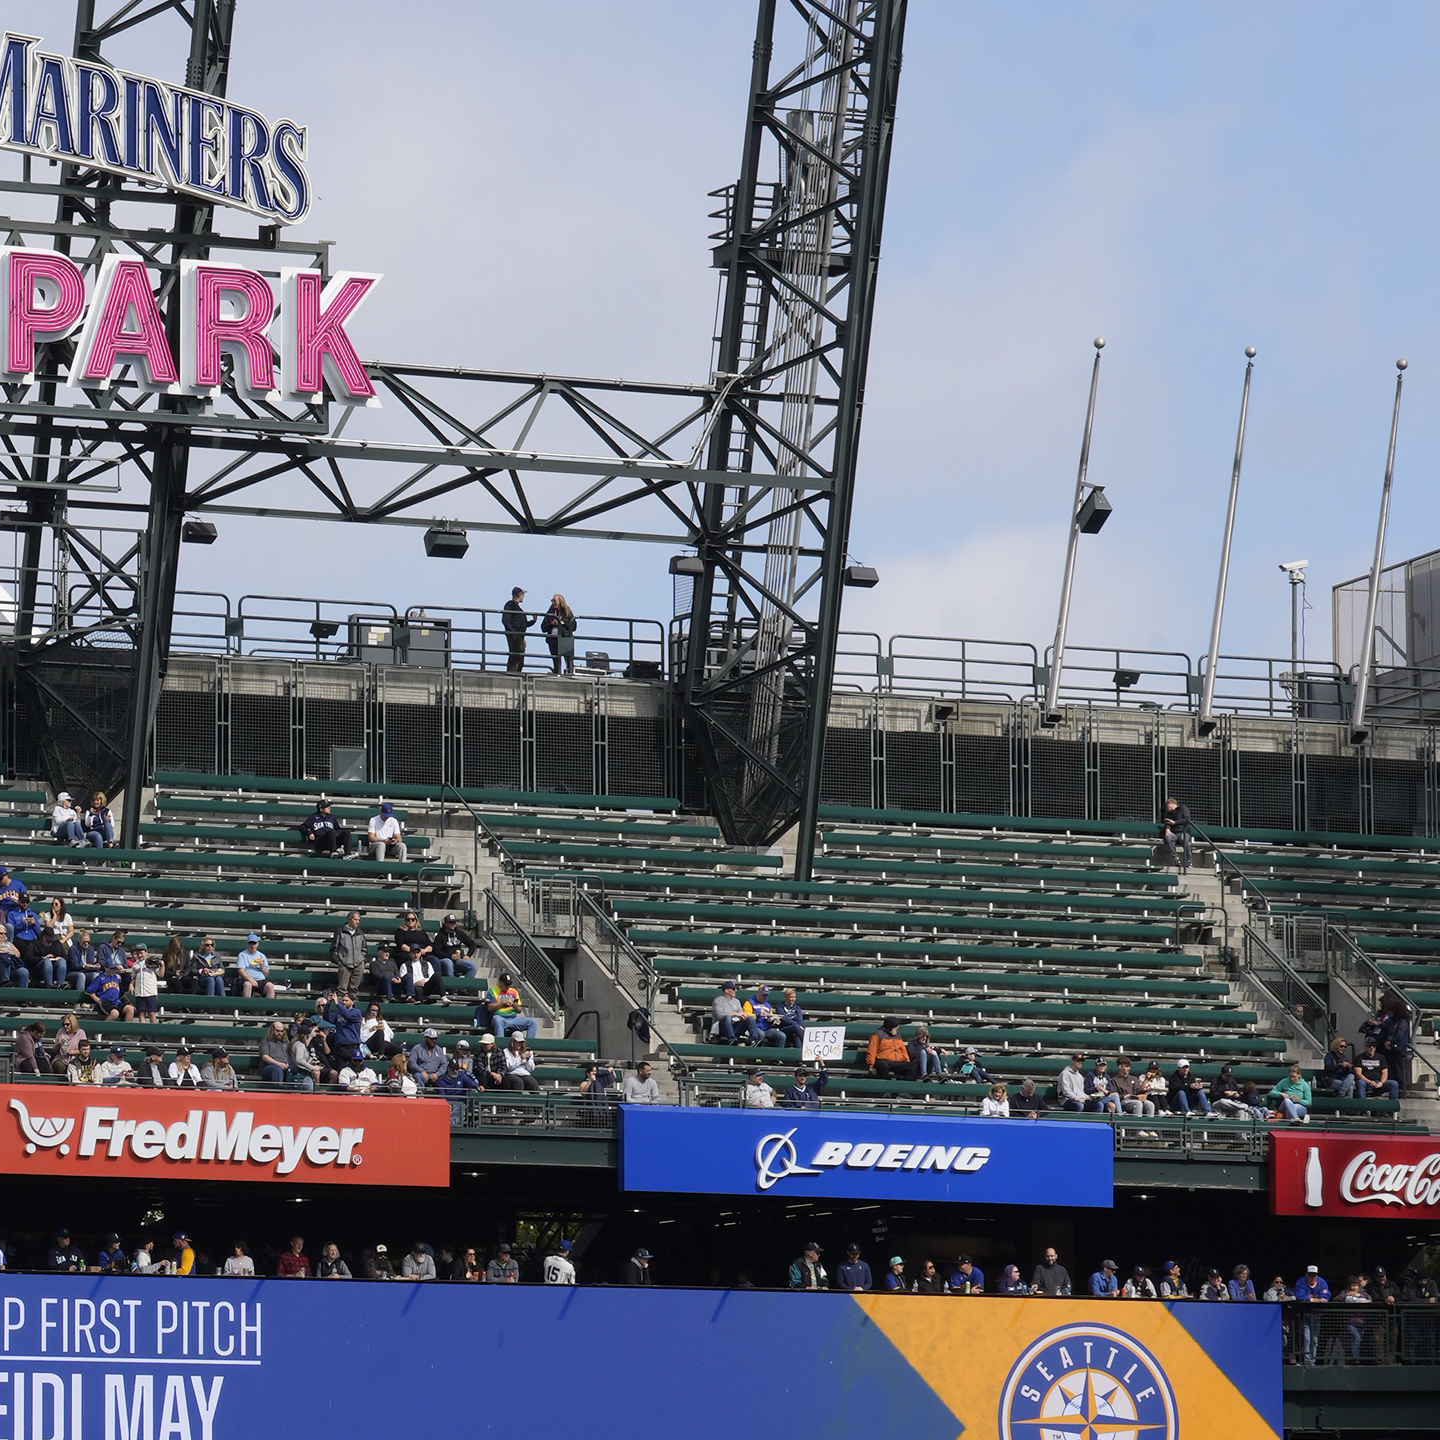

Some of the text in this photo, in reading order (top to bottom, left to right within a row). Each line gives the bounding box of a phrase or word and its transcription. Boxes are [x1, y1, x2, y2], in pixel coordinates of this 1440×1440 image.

[809, 1031, 838, 1044] LETS
[810, 1140, 992, 1172] BOEING
[546, 1264, 559, 1282] 15
[41, 1298, 142, 1355] FIRST
[156, 1300, 262, 1357] PITCH
[1021, 1342, 1156, 1402] SEATTLE
